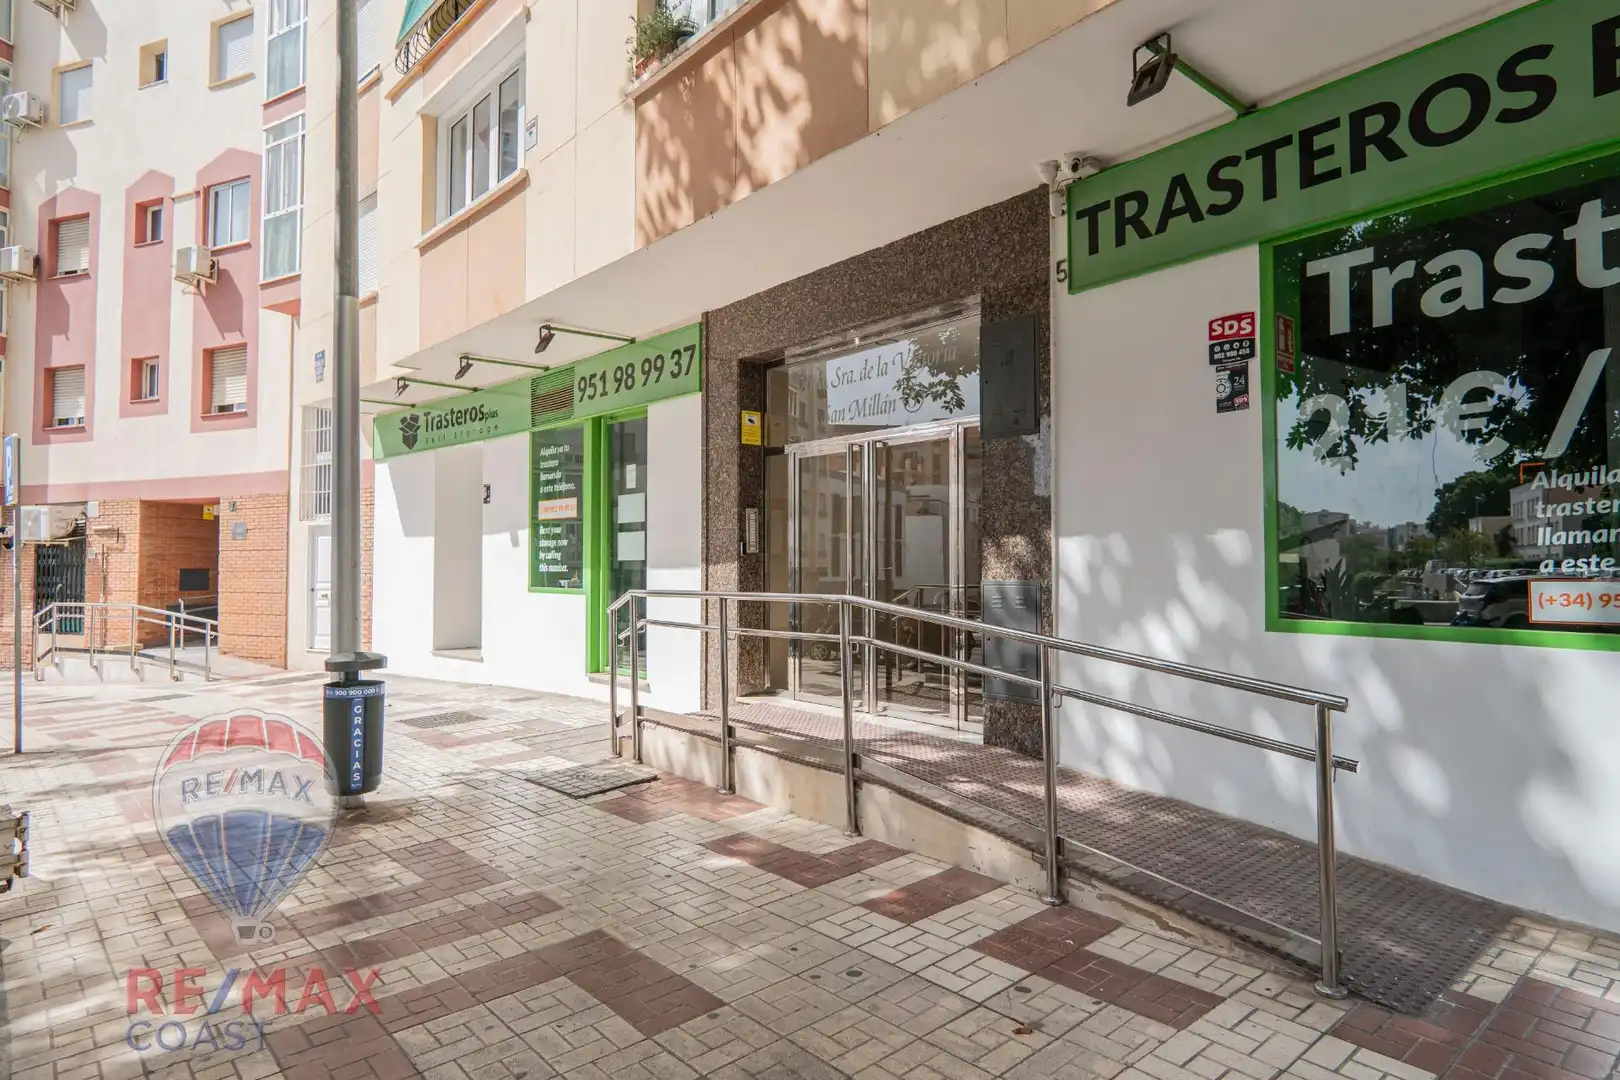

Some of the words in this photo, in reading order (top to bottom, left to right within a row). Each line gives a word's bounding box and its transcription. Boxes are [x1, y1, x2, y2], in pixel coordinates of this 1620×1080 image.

[1075, 44, 1557, 256] TRASTEROS
[1056, 259, 1068, 283] 5
[1306, 198, 1620, 336] Trast
[1211, 318, 1252, 336] SDS
[578, 370, 608, 403] 951
[613, 362, 635, 394] 98
[641, 354, 665, 387] 99
[670, 344, 697, 379] 37
[830, 366, 857, 388] Sra.
[860, 358, 874, 382] de
[877, 355, 888, 378] la
[424, 404, 484, 433] Trasteros
[484, 408, 499, 422] plus
[848, 394, 897, 421] Millán
[1531, 464, 1620, 491] Alquila
[1540, 558, 1555, 574] a
[1561, 553, 1616, 574] este
[1538, 592, 1593, 611] (+34)
[352, 705, 362, 781] GRACIAS
